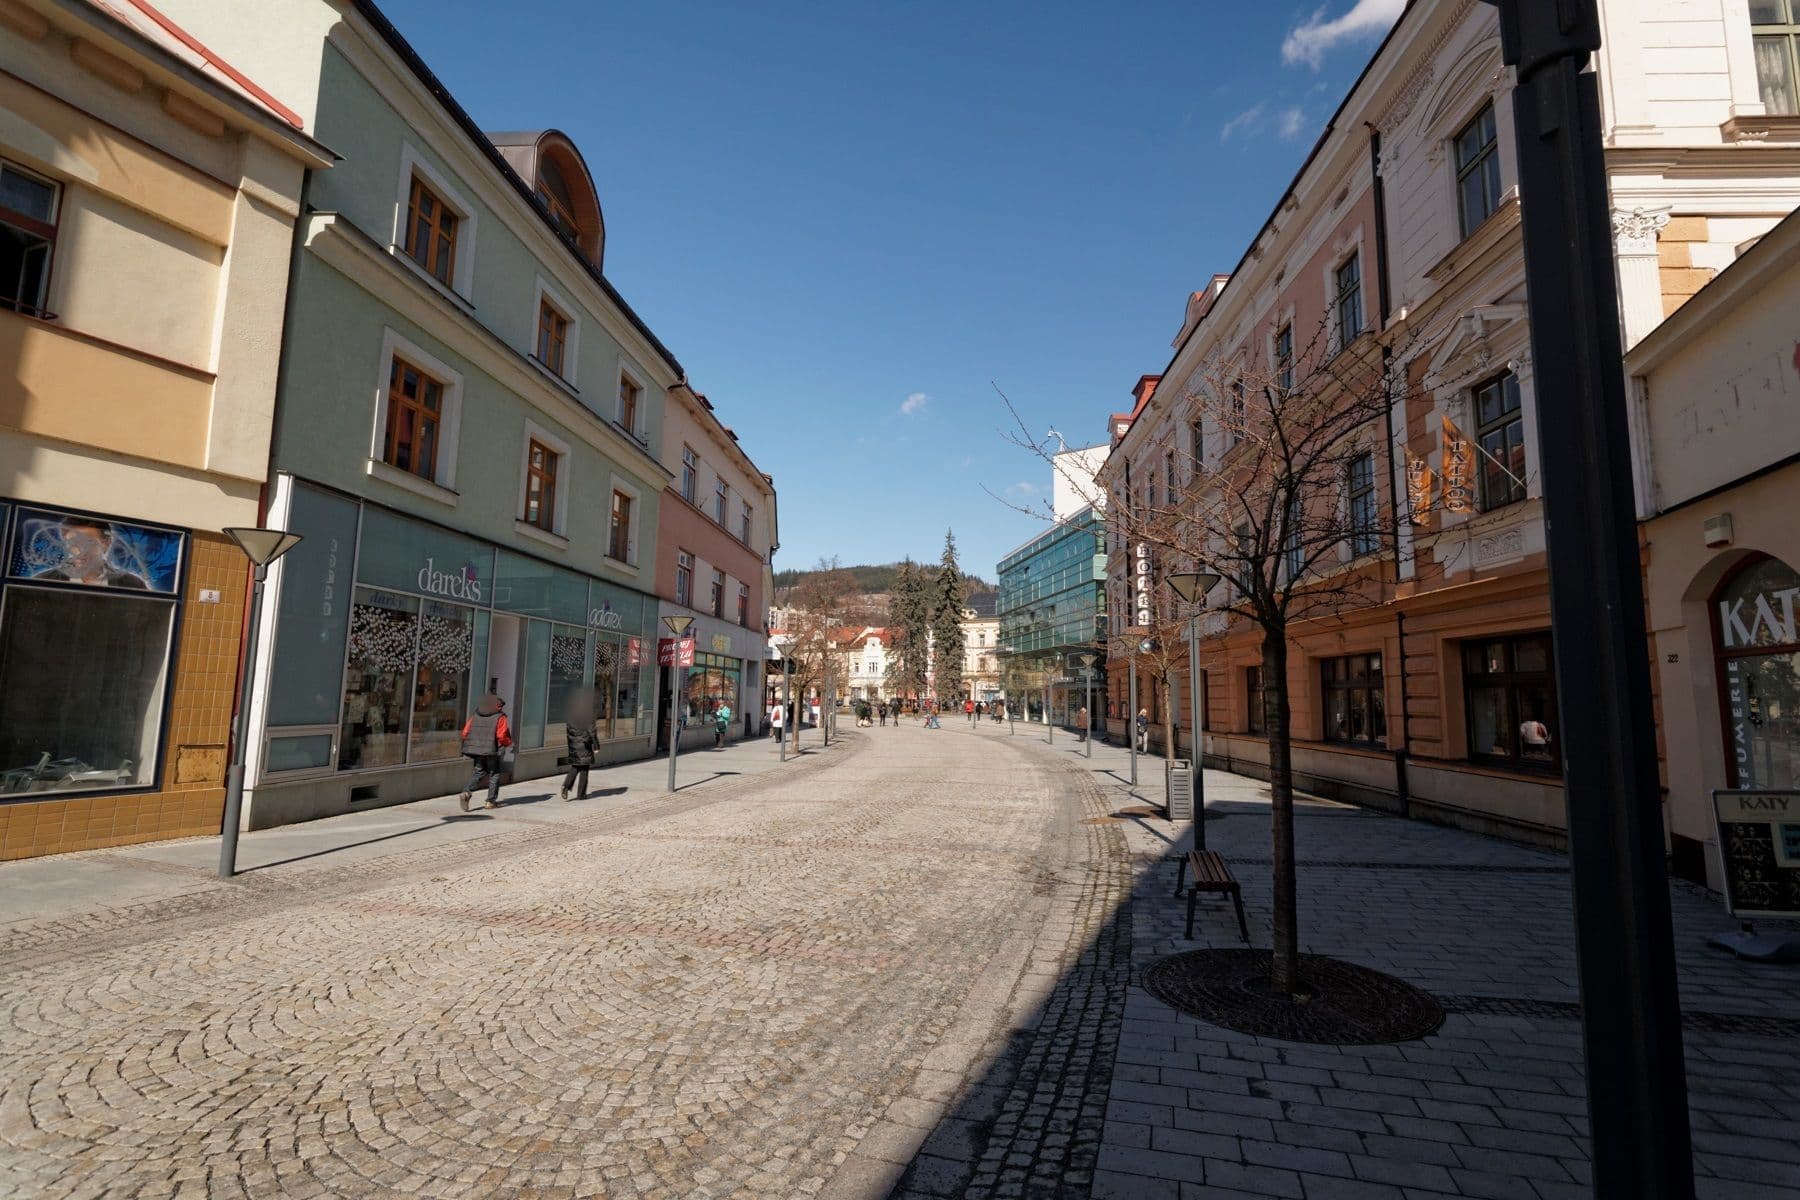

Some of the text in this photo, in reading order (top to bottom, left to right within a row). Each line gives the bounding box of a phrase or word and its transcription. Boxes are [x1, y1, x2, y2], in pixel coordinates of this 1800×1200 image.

[1447, 440, 1467, 511] TATTOO
[1138, 545, 1152, 624] HOTEL
[1739, 796, 1790, 811] KATY
